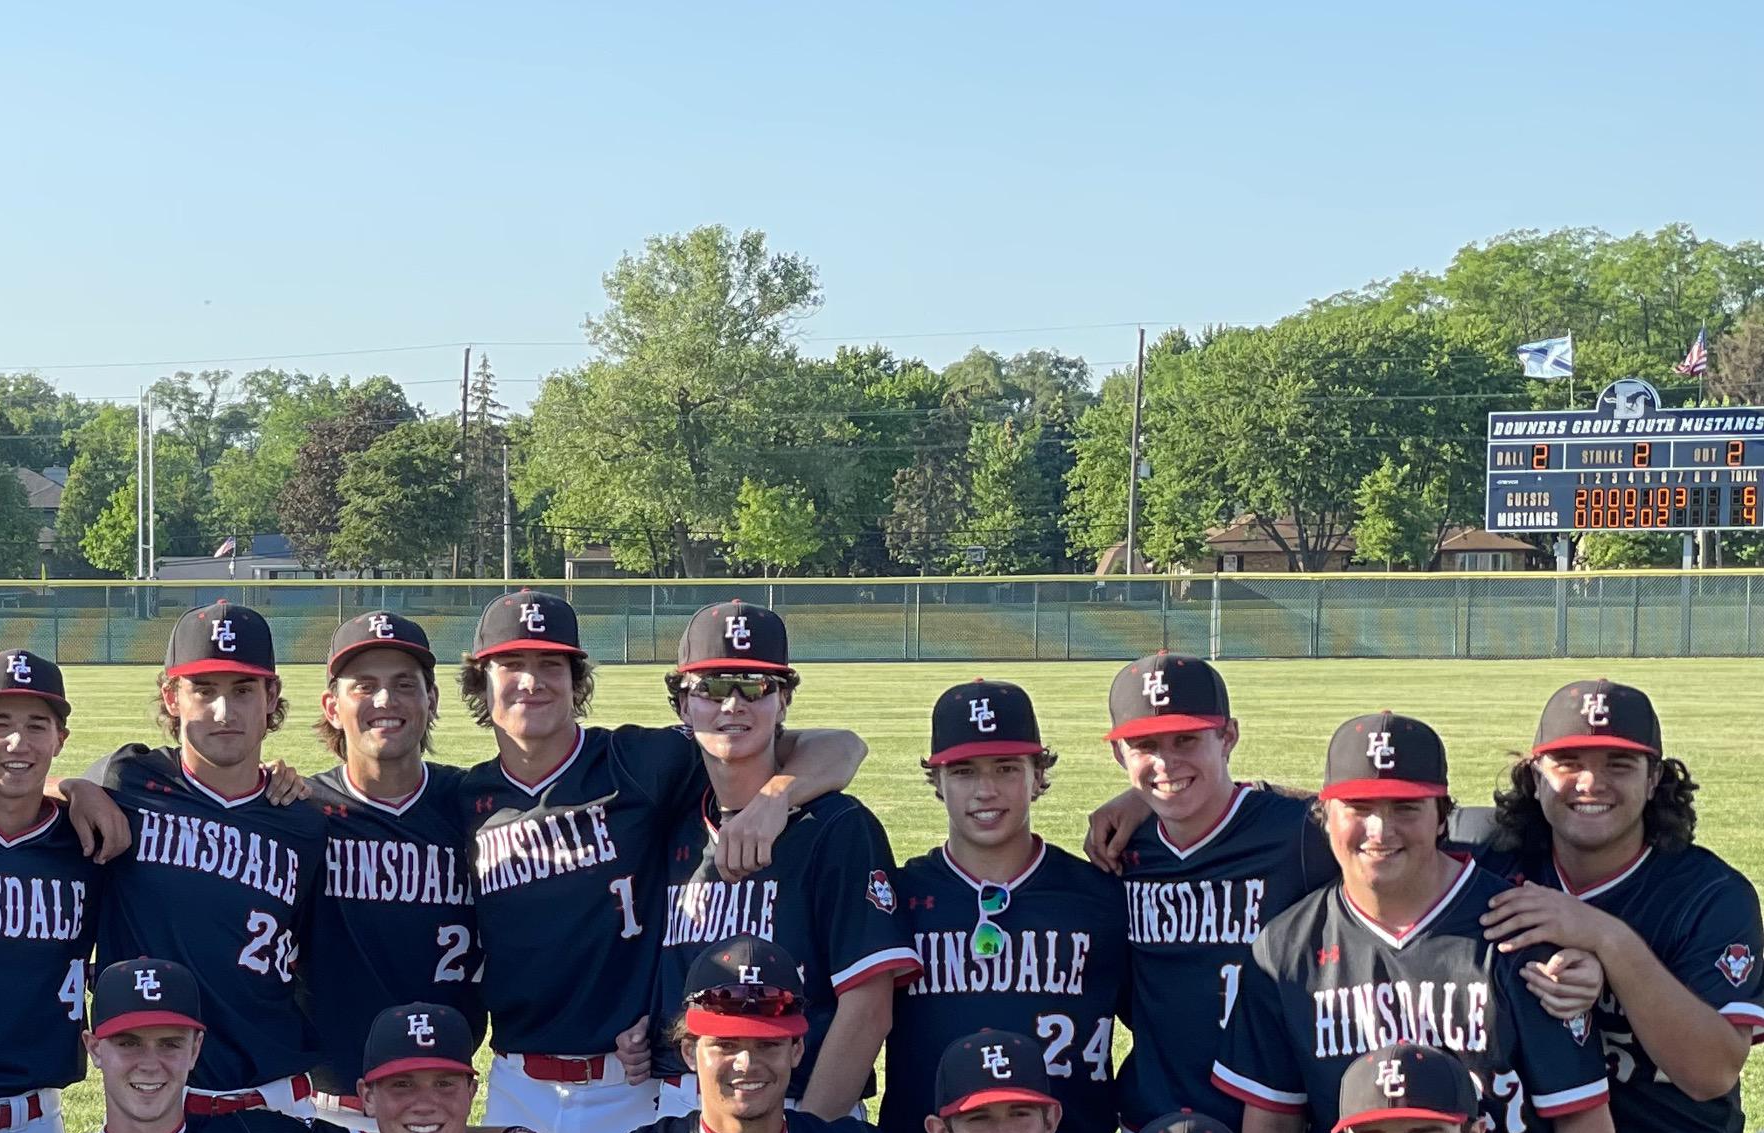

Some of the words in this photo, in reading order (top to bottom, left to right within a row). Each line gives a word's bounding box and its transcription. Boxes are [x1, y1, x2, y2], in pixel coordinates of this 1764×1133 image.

[1493, 420, 1567, 436] DOWNERS
[1572, 420, 1621, 434] GROVE
[1625, 418, 1676, 433] SOUTH
[1679, 416, 1764, 432] MUSTANGS
[1496, 450, 1524, 466] BALL
[1533, 444, 1548, 469] 2
[1582, 449, 1623, 464] STRIKE
[1634, 442, 1650, 467] 2
[1694, 447, 1717, 462] OUT
[1727, 440, 1743, 466] 2
[1595, 473, 1601, 484] 2
[1611, 472, 1617, 484] 3
[1628, 471, 1634, 483] 4
[1644, 471, 1650, 483] 5
[1678, 471, 1683, 483] 7
[1730, 470, 1757, 482] TOTAL
[1507, 492, 1550, 506] GUESTS
[1576, 490, 1587, 507] 2
[1592, 489, 1604, 507] 0
[1608, 489, 1620, 507] 0
[1625, 488, 1636, 507] 0
[1658, 488, 1669, 507] 0
[1676, 488, 1687, 507] 3
[1744, 486, 1755, 505] 6
[1497, 512, 1558, 526] MUSTANGS
[1575, 509, 1586, 527] 0
[1591, 509, 1603, 527] 0
[1607, 509, 1619, 527] 0
[1625, 509, 1635, 527] 2
[1641, 509, 1652, 527] 0
[1657, 509, 1668, 527] 2
[1744, 508, 1755, 525] 4
[137, 808, 298, 905] HINSDALE
[476, 806, 617, 895] HINSDALE
[610, 876, 642, 939] 1
[58, 957, 86, 1021] 4
[1314, 982, 1488, 1058] HINSDALE
[1037, 1013, 1112, 1081] 24
